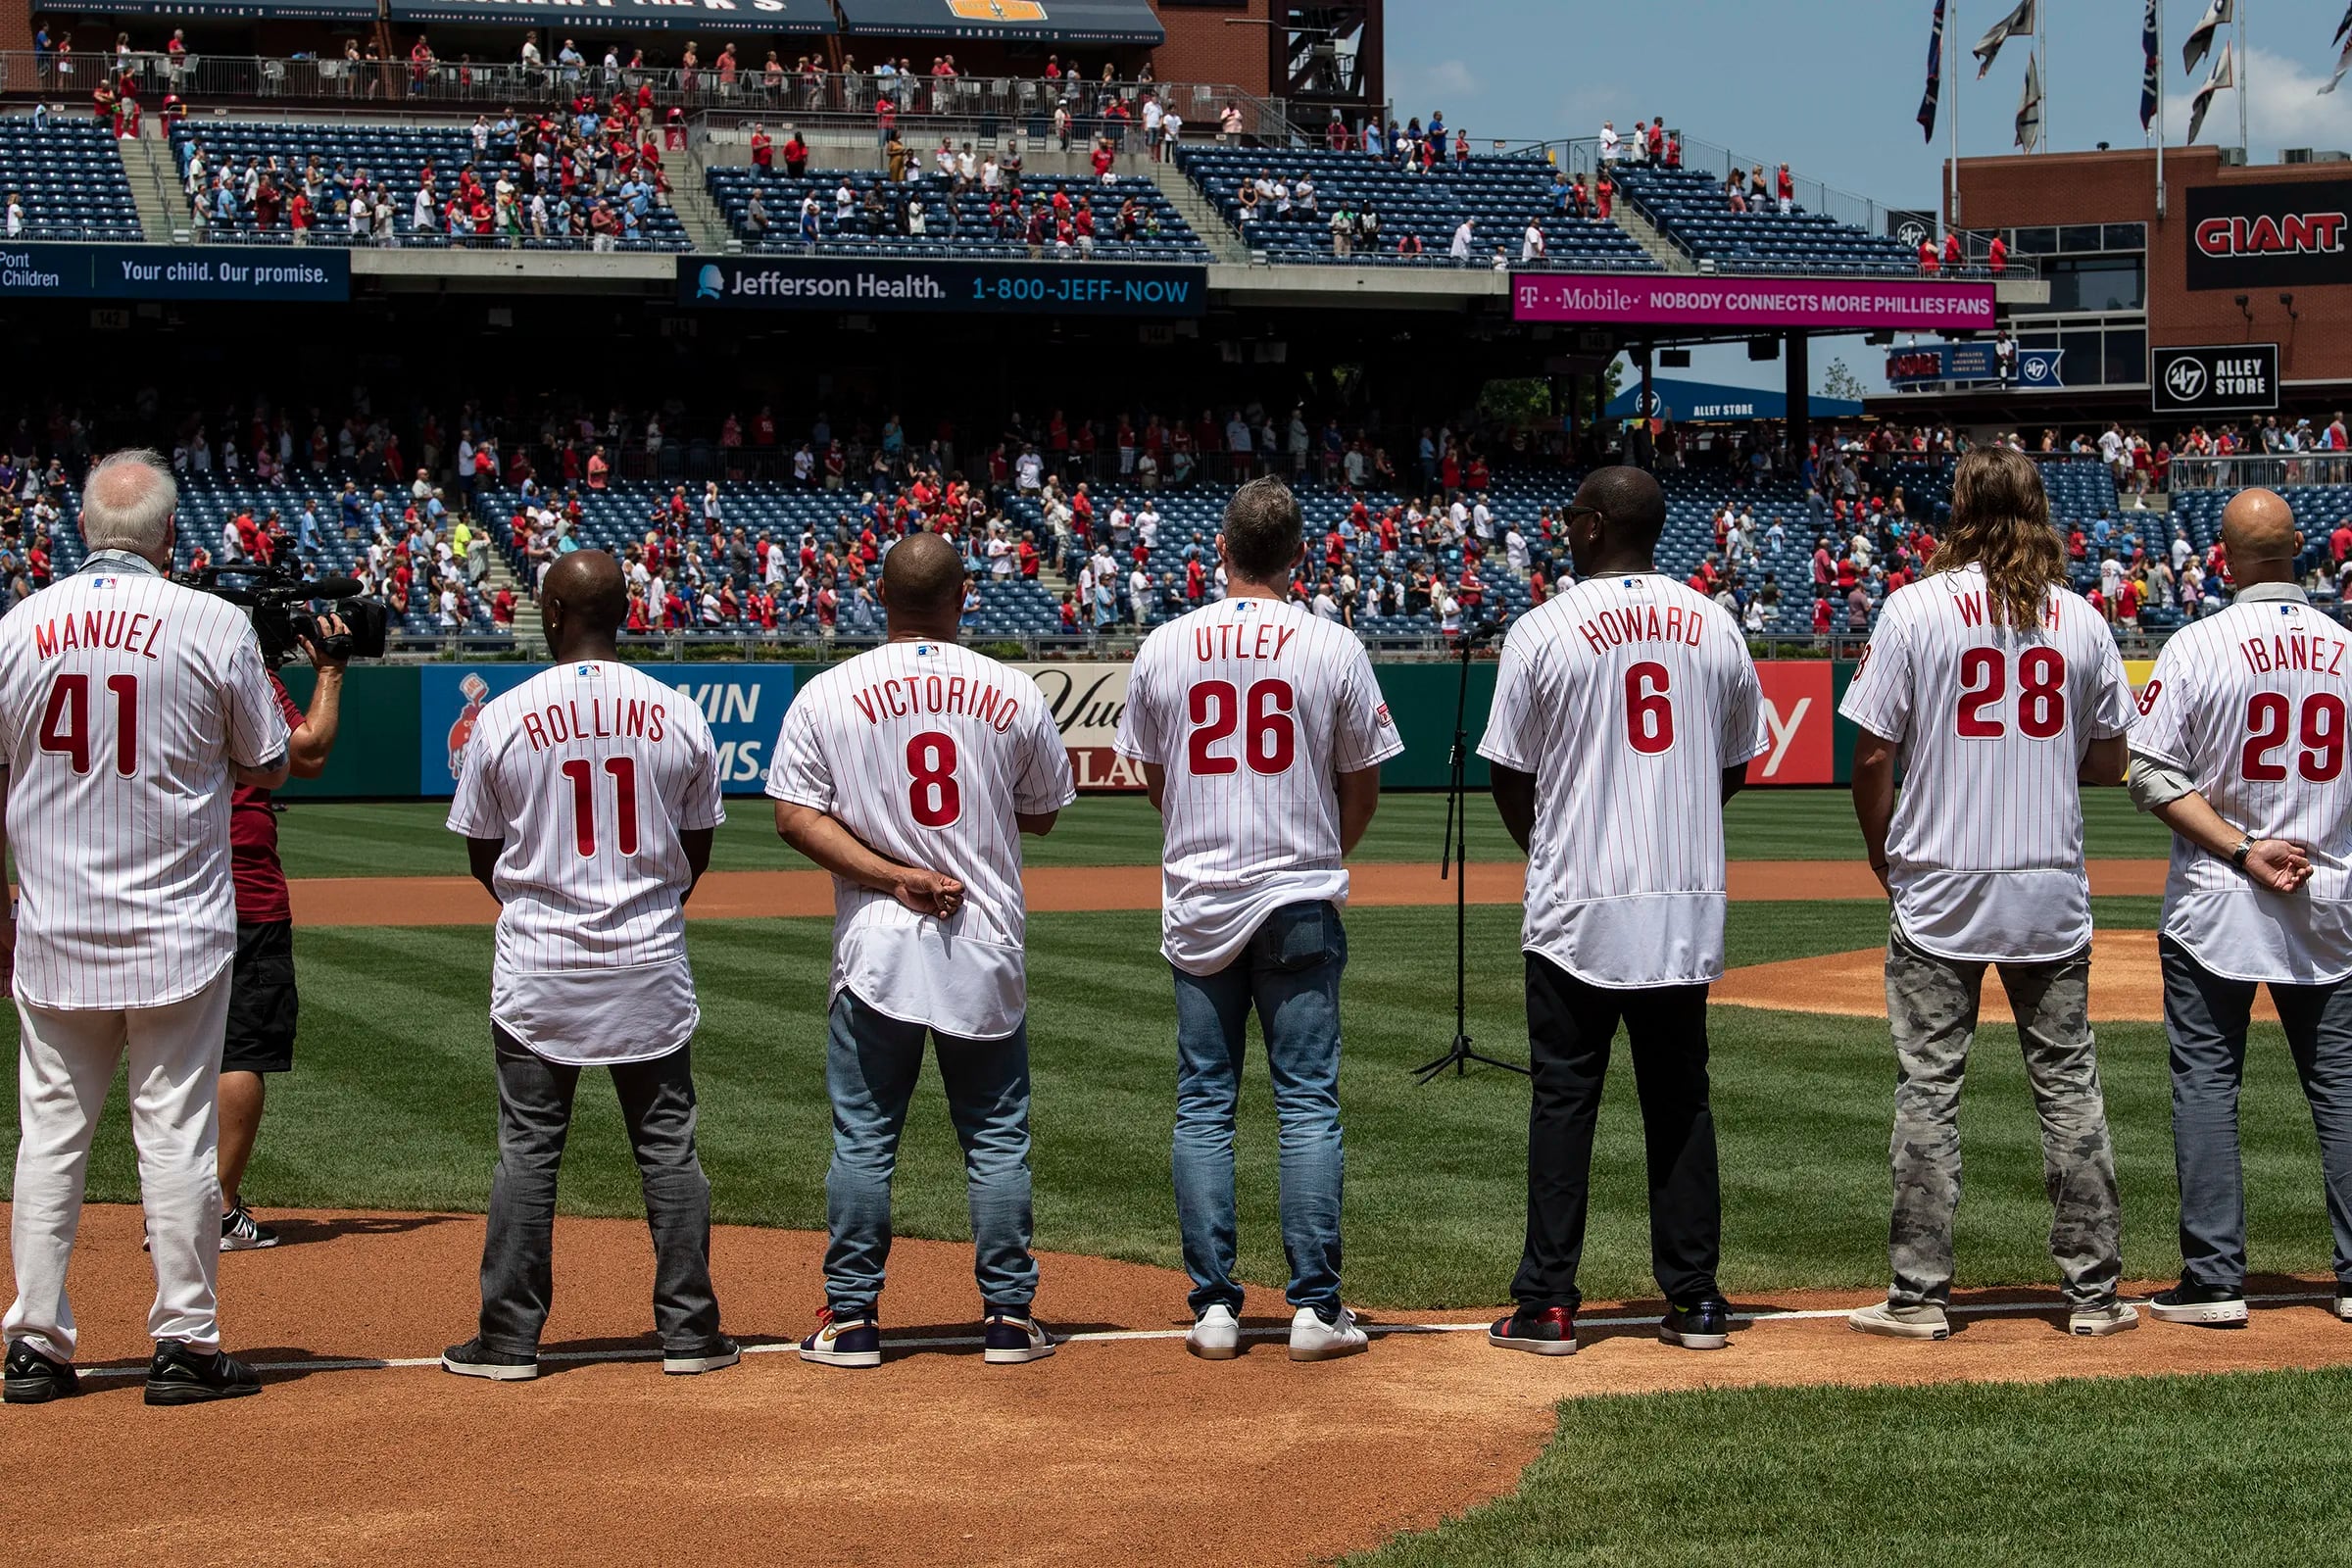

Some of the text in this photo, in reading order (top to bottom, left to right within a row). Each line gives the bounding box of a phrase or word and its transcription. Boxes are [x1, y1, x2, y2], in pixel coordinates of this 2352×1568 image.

[154, 5, 205, 14] HARRY
[564, 17, 613, 26] HARRY
[956, 28, 1004, 37] HARRY
[2195, 212, 2347, 258] GIANT
[0, 251, 29, 268] Pont
[2, 270, 59, 287] Children
[122, 260, 329, 286] Your child. Our promise.
[731, 270, 851, 299] Jefferson
[972, 277, 1189, 304] 1-800-JEFF-NOW
[1649, 292, 1990, 316] NOBODY CONNECTS MORE PHILLIES FANS
[1587, 334, 1606, 348] 145
[2215, 377, 2265, 395] STORE
[2216, 359, 2263, 376] ALLEY
[1693, 403, 1754, 416] ALLEY STORE
[35, 610, 163, 662] MANUEL
[1196, 623, 1296, 662] UTLEY
[1578, 605, 1703, 657] HOWARD
[2240, 626, 2346, 678] IBAÑEZ
[853, 675, 1019, 734] VICTORINO
[1624, 660, 1677, 757] 6
[1956, 645, 2067, 741] 28
[39, 671, 141, 779] 41
[522, 697, 666, 754] ROLLINS
[1188, 677, 1296, 776] 26
[2241, 692, 2346, 784] 29
[906, 729, 963, 830] 8
[560, 754, 640, 859] 11
